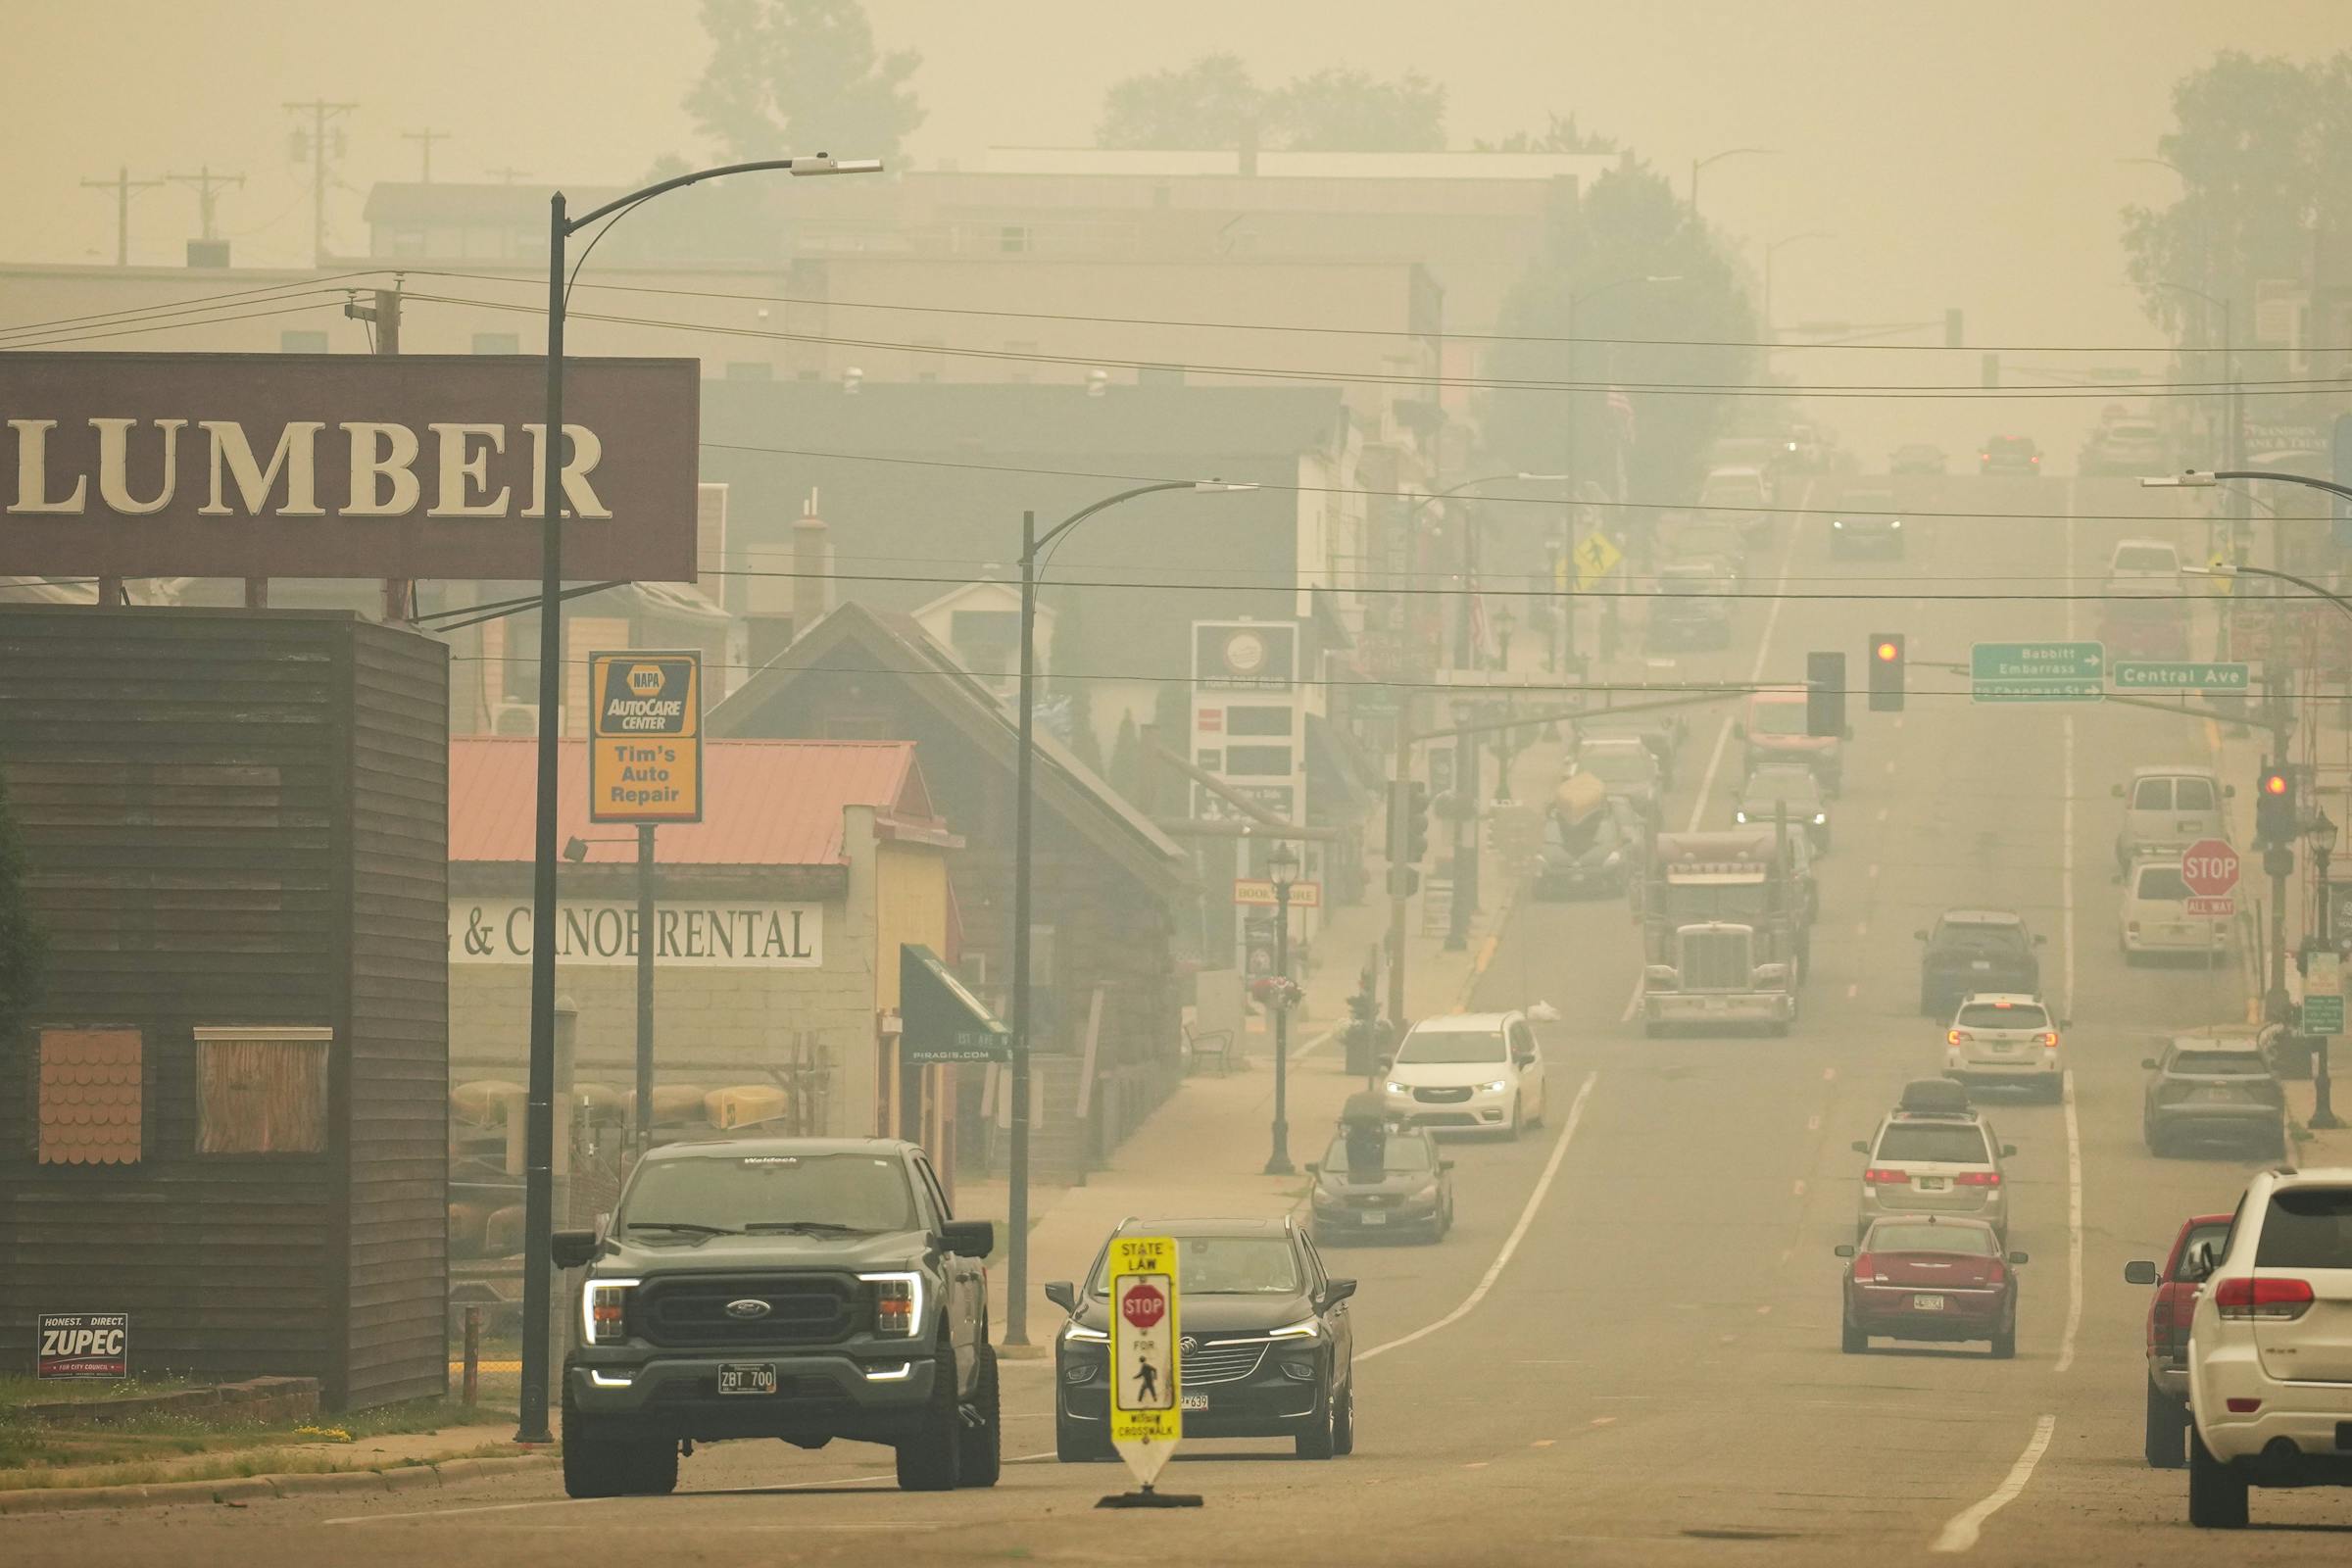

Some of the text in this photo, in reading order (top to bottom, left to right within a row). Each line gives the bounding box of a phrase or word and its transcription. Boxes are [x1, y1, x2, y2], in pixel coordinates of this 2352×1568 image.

[6, 417, 613, 520] LUMBER
[2022, 649, 2076, 659] Babbitt
[1999, 663, 2076, 675] Embarrass
[2123, 668, 2240, 683] Central Ave
[633, 672, 660, 688] NAPA
[1993, 685, 2062, 699] Chapman
[2065, 685, 2080, 697] St
[621, 715, 665, 730] CENTER
[614, 745, 676, 762] Tim's
[622, 766, 669, 782] Auto
[611, 786, 680, 807] Repair
[2186, 857, 2237, 879] STOP
[2189, 901, 2233, 912] ALL WAY
[505, 906, 639, 957] CNOE
[656, 908, 812, 958] RENTAL
[912, 1052, 989, 1060] PIRAGIS.COM
[1121, 1242, 1163, 1256] STATE
[1128, 1257, 1157, 1271] LAW
[1124, 1298, 1162, 1316] STOP
[44, 1317, 123, 1327] HONEST. DIRECT.
[40, 1329, 125, 1356] ZUPEC
[1133, 1340, 1155, 1351] FOR
[721, 1371, 773, 1387] ZBT 700
[1118, 1426, 1173, 1437] CROSSWALK
